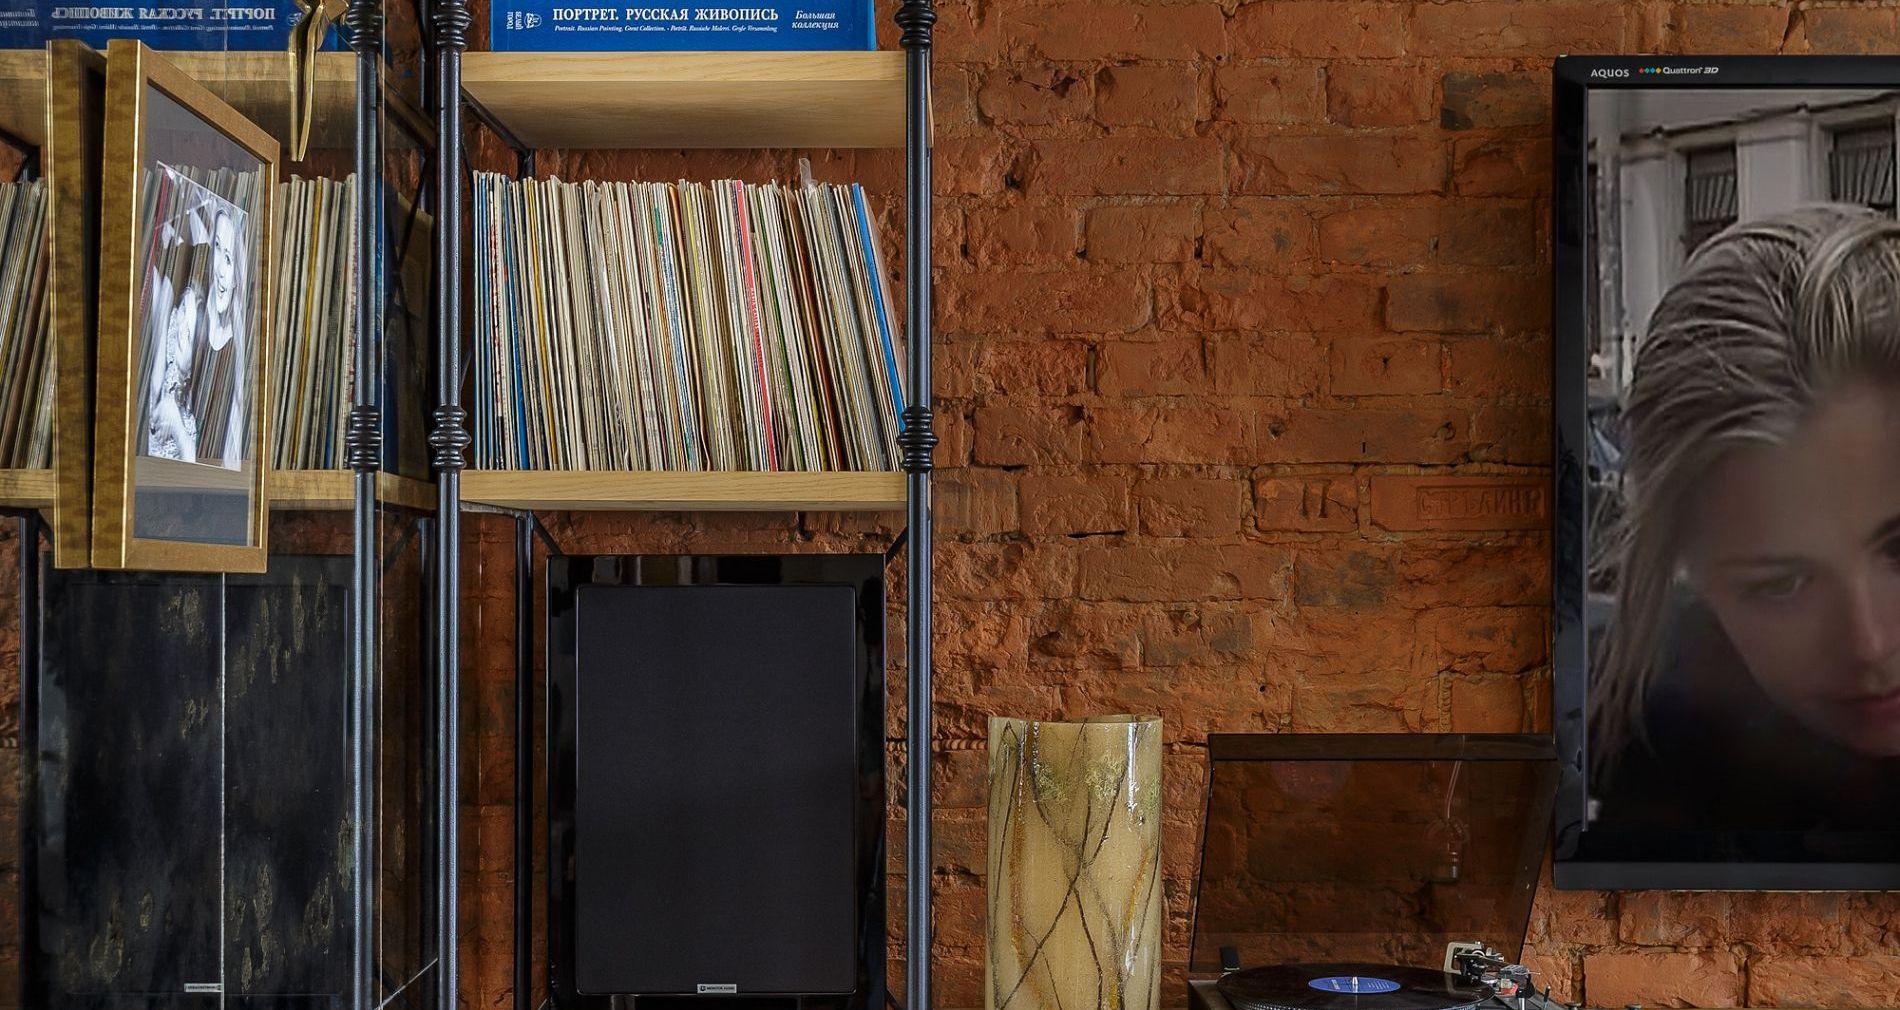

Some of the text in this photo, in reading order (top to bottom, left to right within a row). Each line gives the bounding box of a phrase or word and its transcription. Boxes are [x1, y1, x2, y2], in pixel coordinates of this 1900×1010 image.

[553, 8, 779, 21] ПОРТРЕТ. РУССКАЯ ЖИВОПИСЬ
[795, 10, 836, 20] Большая
[791, 20, 839, 30] коллекция
[1590, 68, 1630, 79] AQUOS
[1662, 66, 1701, 75] Quattron
